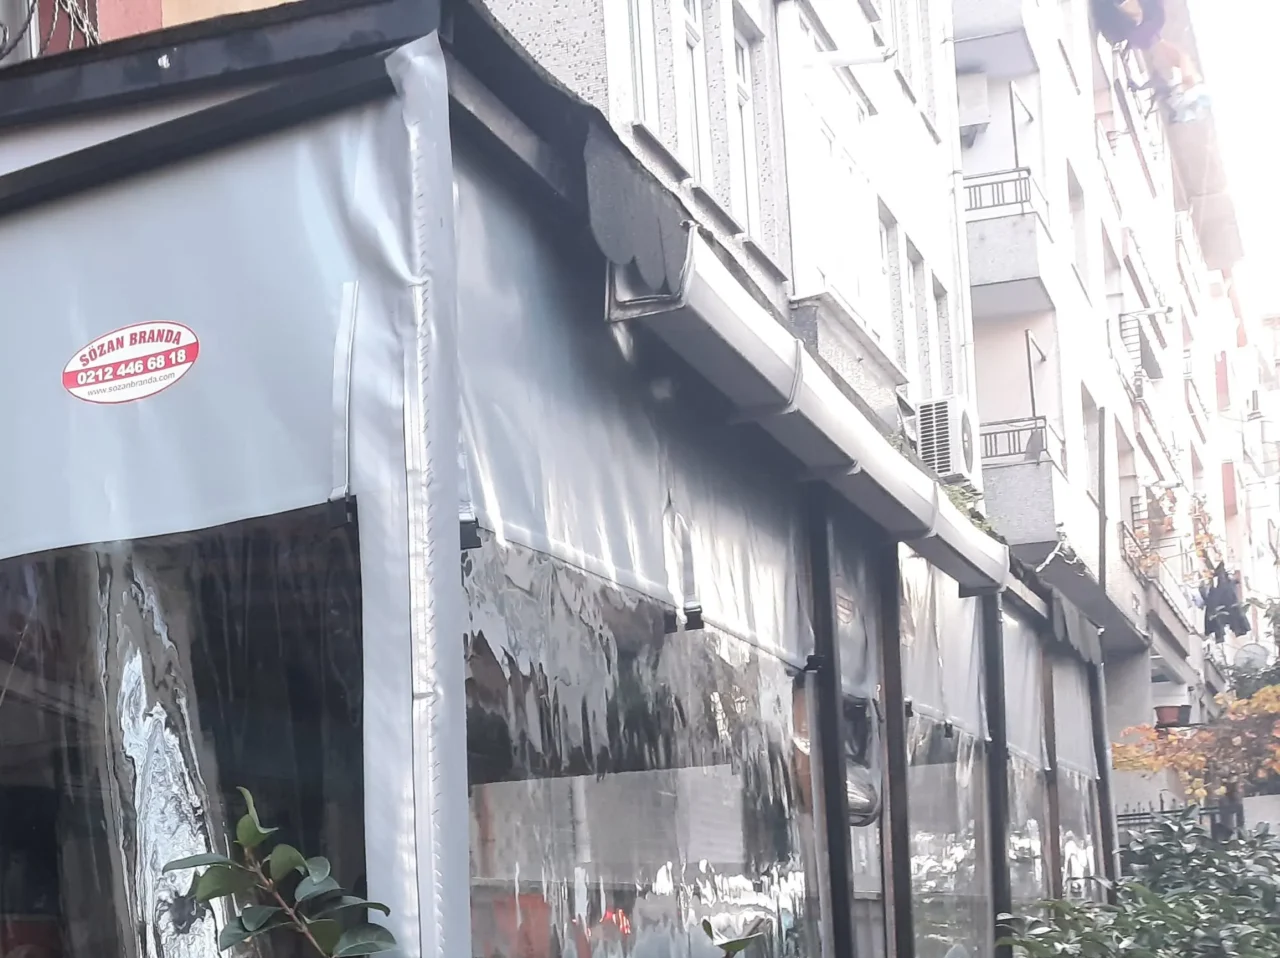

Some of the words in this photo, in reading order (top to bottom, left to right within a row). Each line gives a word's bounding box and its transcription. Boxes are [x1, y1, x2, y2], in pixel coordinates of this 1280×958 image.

[79, 335, 124, 367] SÖZAN
[129, 328, 182, 346] BRANDA
[77, 366, 113, 385] 0212
[116, 360, 144, 376] 446
[147, 355, 165, 370] 68
[169, 349, 186, 365] 18
[87, 371, 175, 396] www.sozanbranda.com
